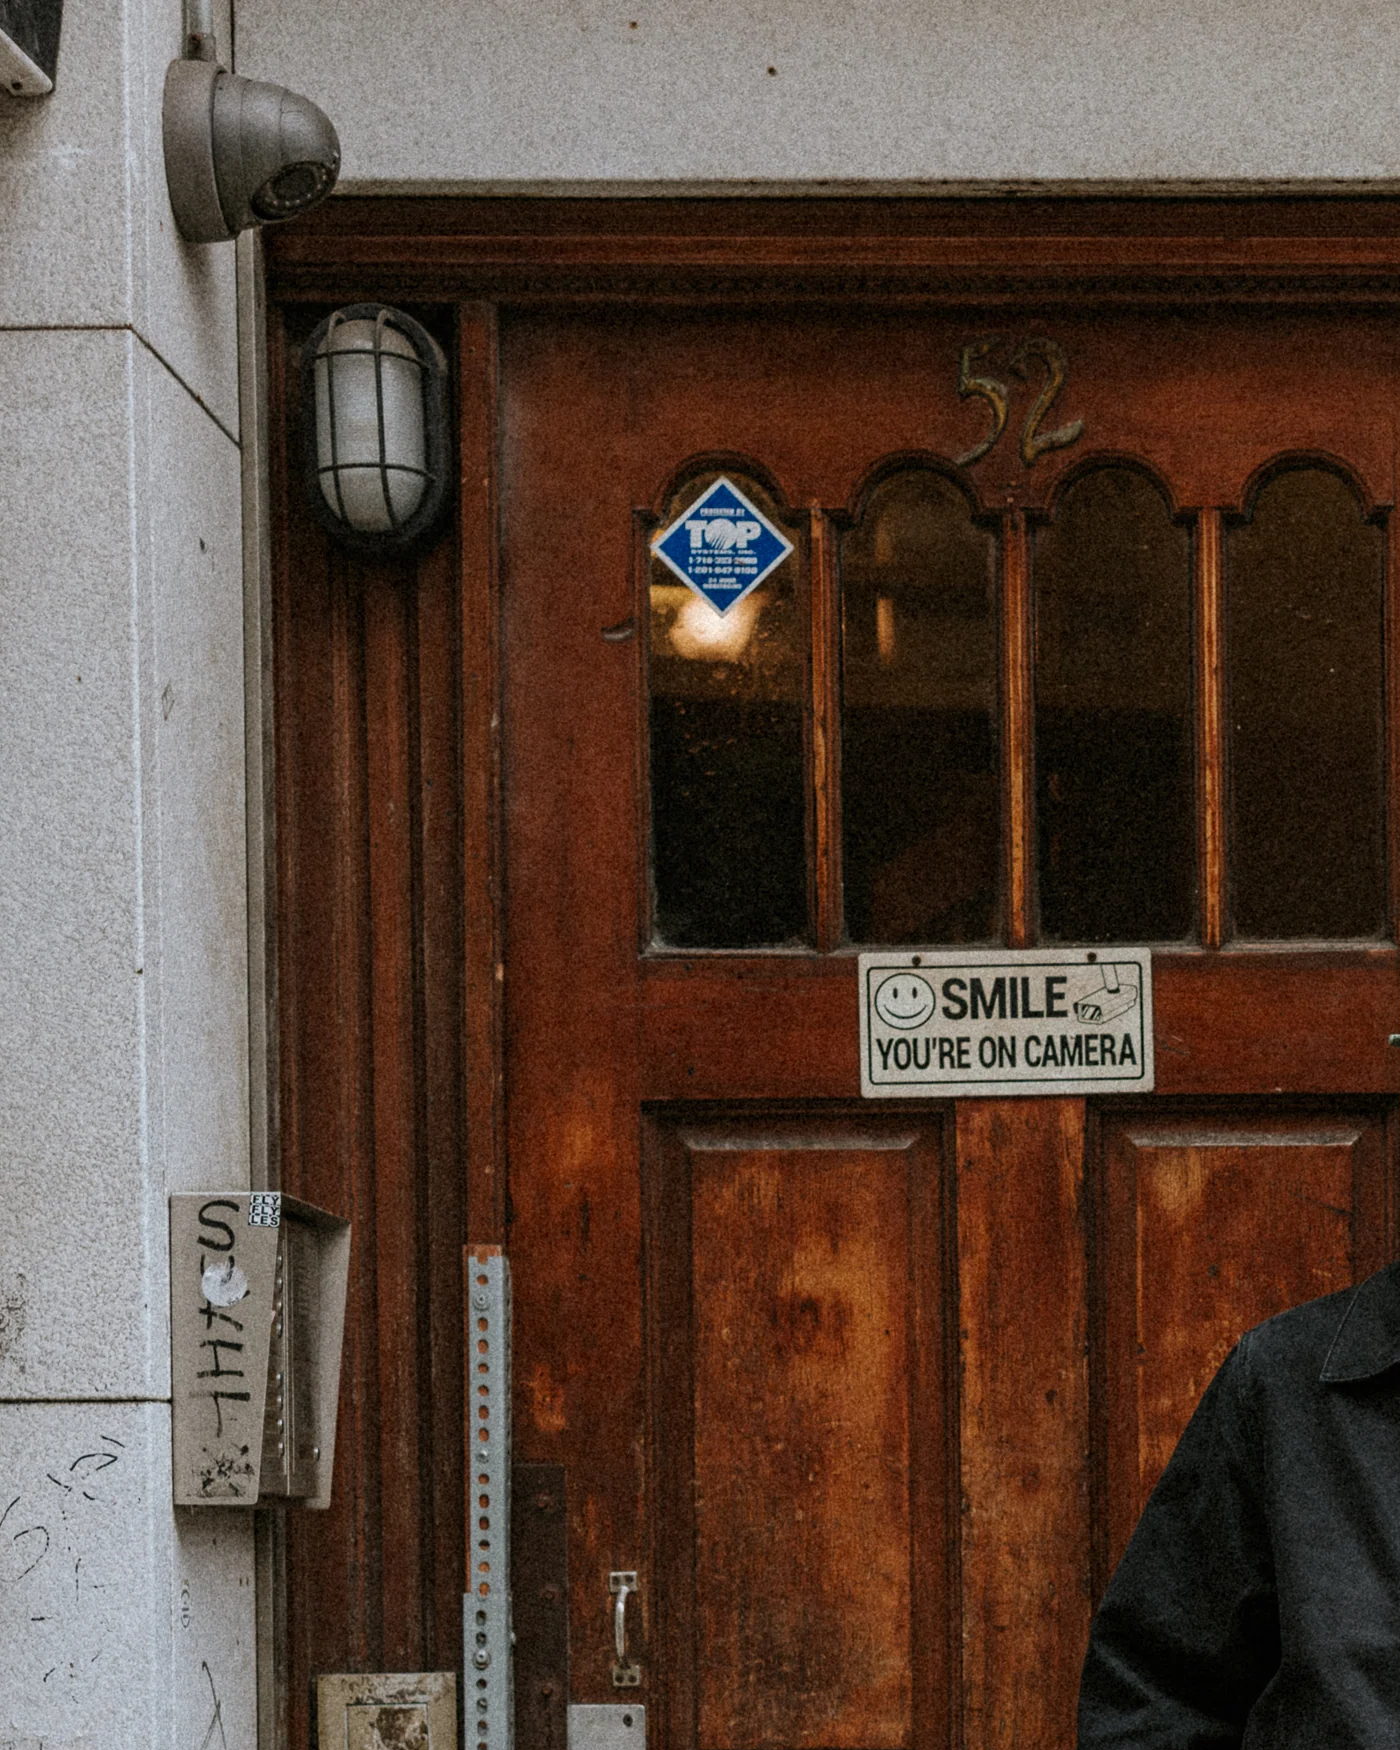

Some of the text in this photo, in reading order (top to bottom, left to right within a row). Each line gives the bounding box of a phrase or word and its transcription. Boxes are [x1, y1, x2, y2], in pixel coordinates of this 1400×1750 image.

[953, 336, 1084, 467] 52
[685, 517, 762, 550] TOP
[941, 976, 1069, 1020] SMILE
[875, 1033, 1137, 1071] YOU'RE ON CAMERA
[252, 1205, 279, 1215] FLY
[253, 1195, 280, 1205] FLY
[250, 1215, 279, 1226] LES
